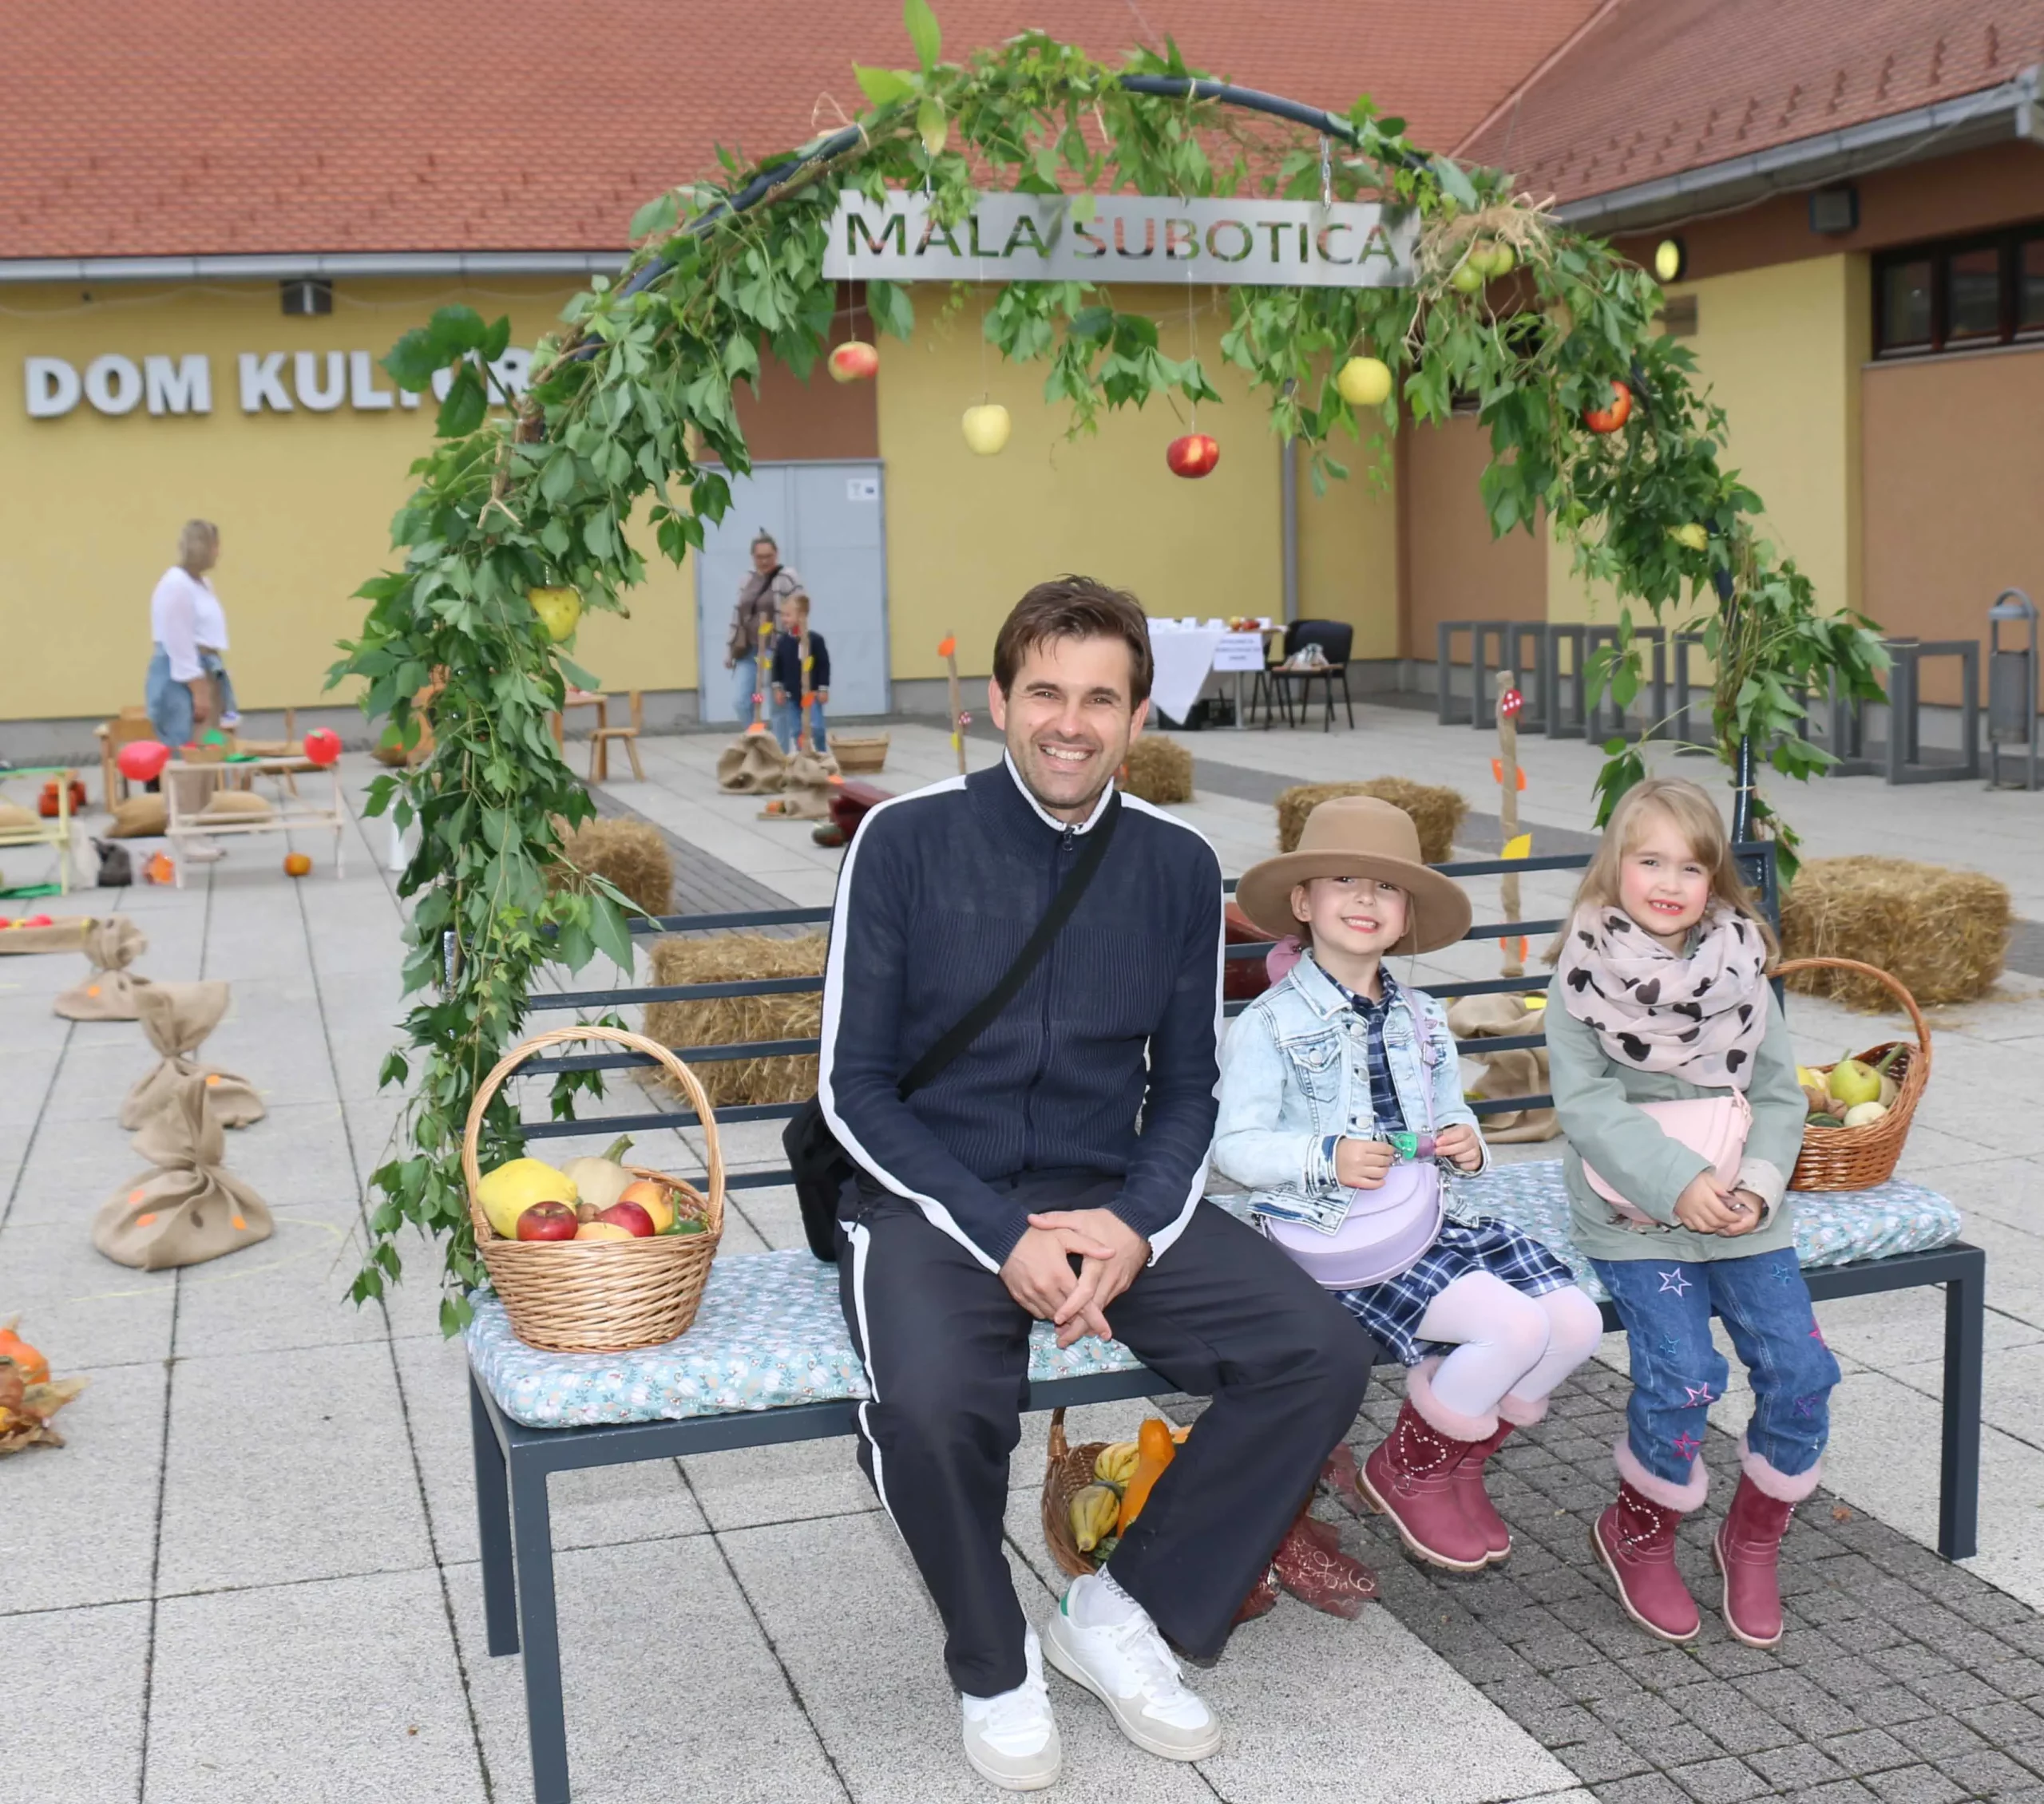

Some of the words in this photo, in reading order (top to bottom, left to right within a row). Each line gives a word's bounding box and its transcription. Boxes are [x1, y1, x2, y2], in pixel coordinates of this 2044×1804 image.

[846, 212, 1051, 259] MALA
[1073, 216, 1400, 270] SUBOTICA
[25, 354, 212, 417] DOM
